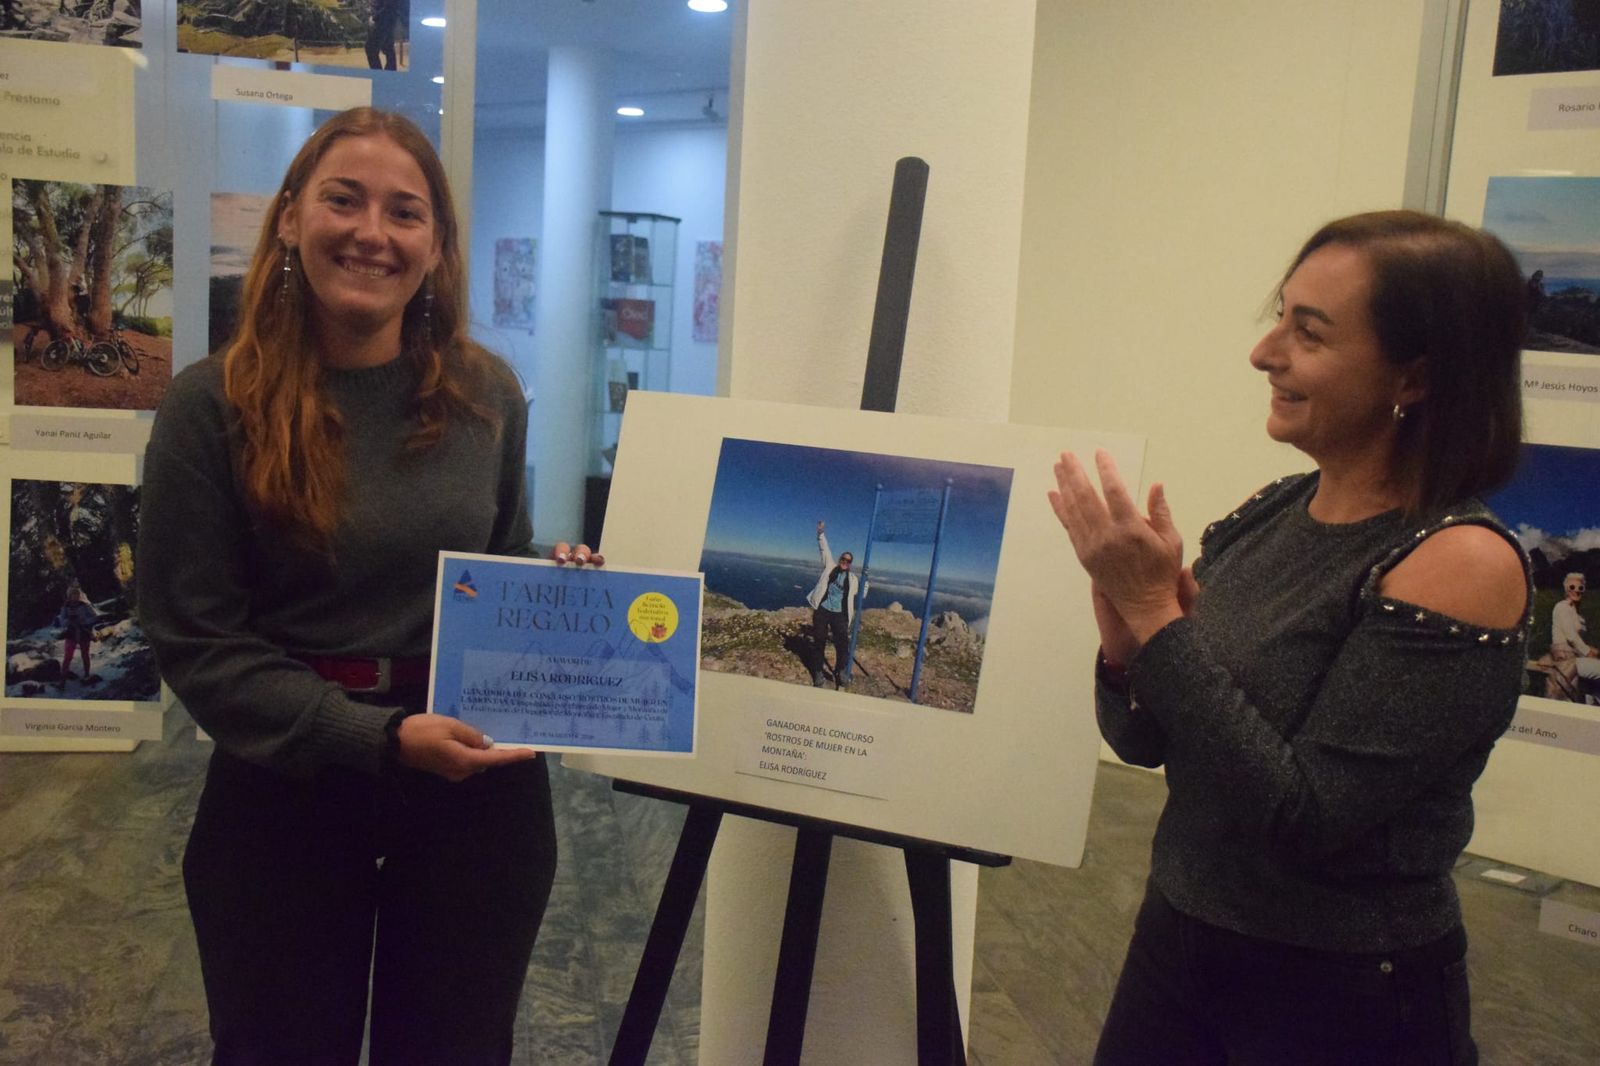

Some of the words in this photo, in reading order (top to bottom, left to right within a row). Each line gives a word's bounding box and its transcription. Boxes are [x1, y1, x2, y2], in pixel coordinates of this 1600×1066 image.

[234, 88, 264, 98] Susana
[265, 91, 294, 102] Ortega
[1558, 103, 1596, 112] Rosario
[83, 431, 112, 441] Aguilar
[500, 580, 614, 609] TARJETA
[497, 606, 611, 634] REGALO
[511, 670, 546, 683] ELISA
[85, 724, 121, 733] Montero
[766, 718, 811, 733] GANADORA
[812, 726, 827, 737] DEL
[828, 729, 874, 744] CONCURSO
[1518, 725, 1533, 734] del
[1535, 728, 1557, 739] Amo
[803, 738, 815, 748] DE
[815, 741, 843, 753] MUJER
[844, 745, 857, 756] EN
[857, 748, 868, 757] LA
[759, 760, 780, 772] ELISA
[1568, 924, 1598, 938] Charo
